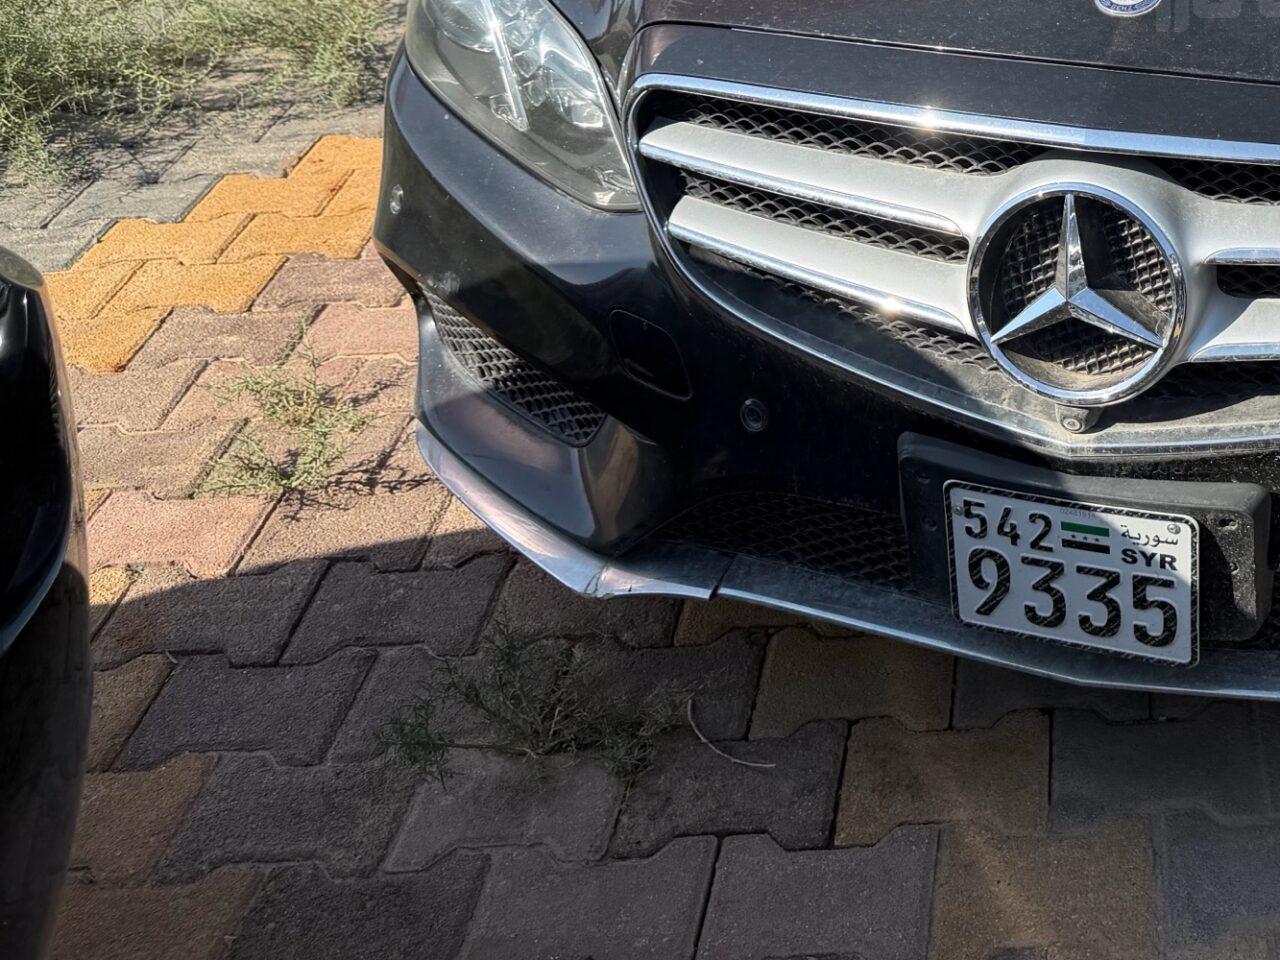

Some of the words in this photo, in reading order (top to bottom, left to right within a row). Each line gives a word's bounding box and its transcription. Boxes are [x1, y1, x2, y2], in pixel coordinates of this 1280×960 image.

[962, 499, 1054, 553] 542
[1119, 523, 1179, 548] سورية
[1120, 548, 1178, 571] SYR
[967, 547, 1178, 648] 9335
